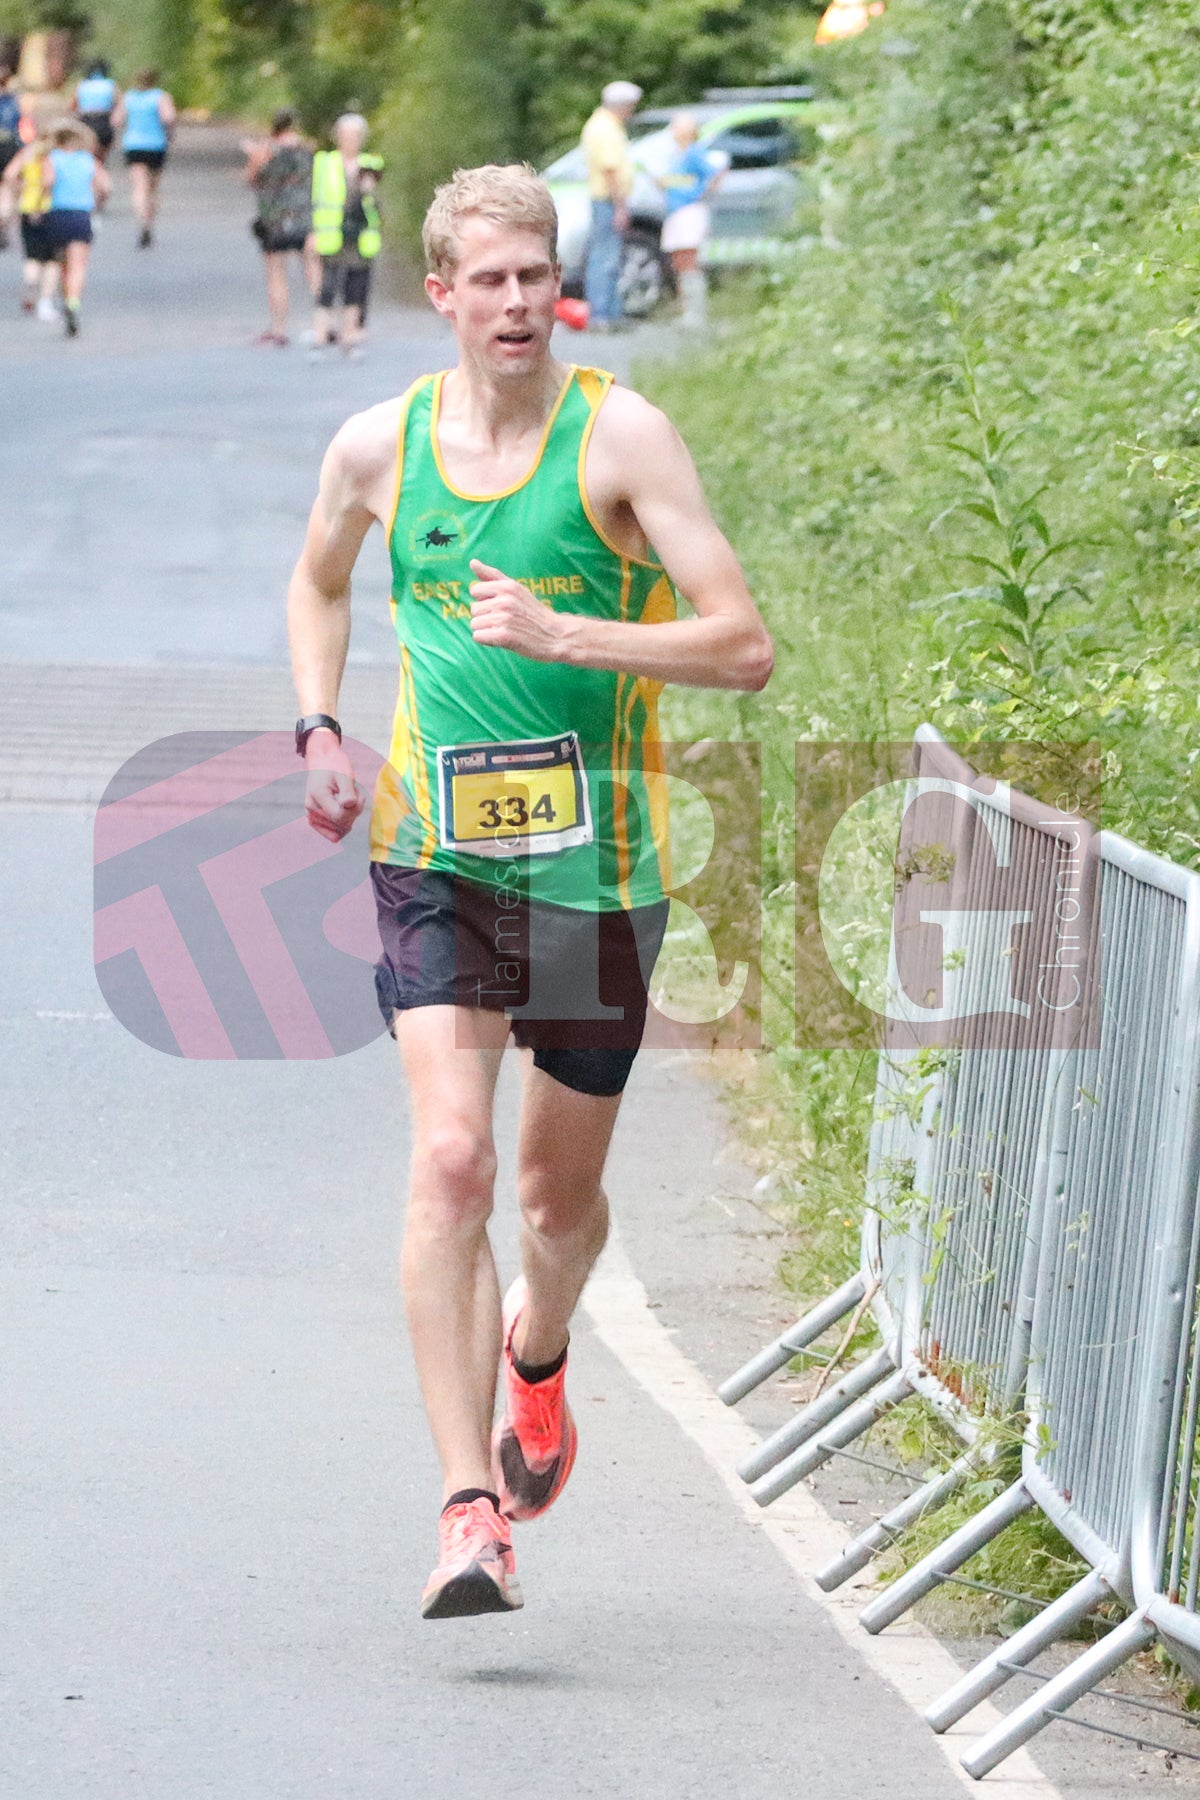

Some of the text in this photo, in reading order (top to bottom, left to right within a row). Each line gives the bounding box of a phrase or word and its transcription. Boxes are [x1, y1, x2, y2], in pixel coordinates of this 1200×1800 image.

[411, 574, 585, 601] EAST SHIRE
[478, 794, 556, 829] 334
